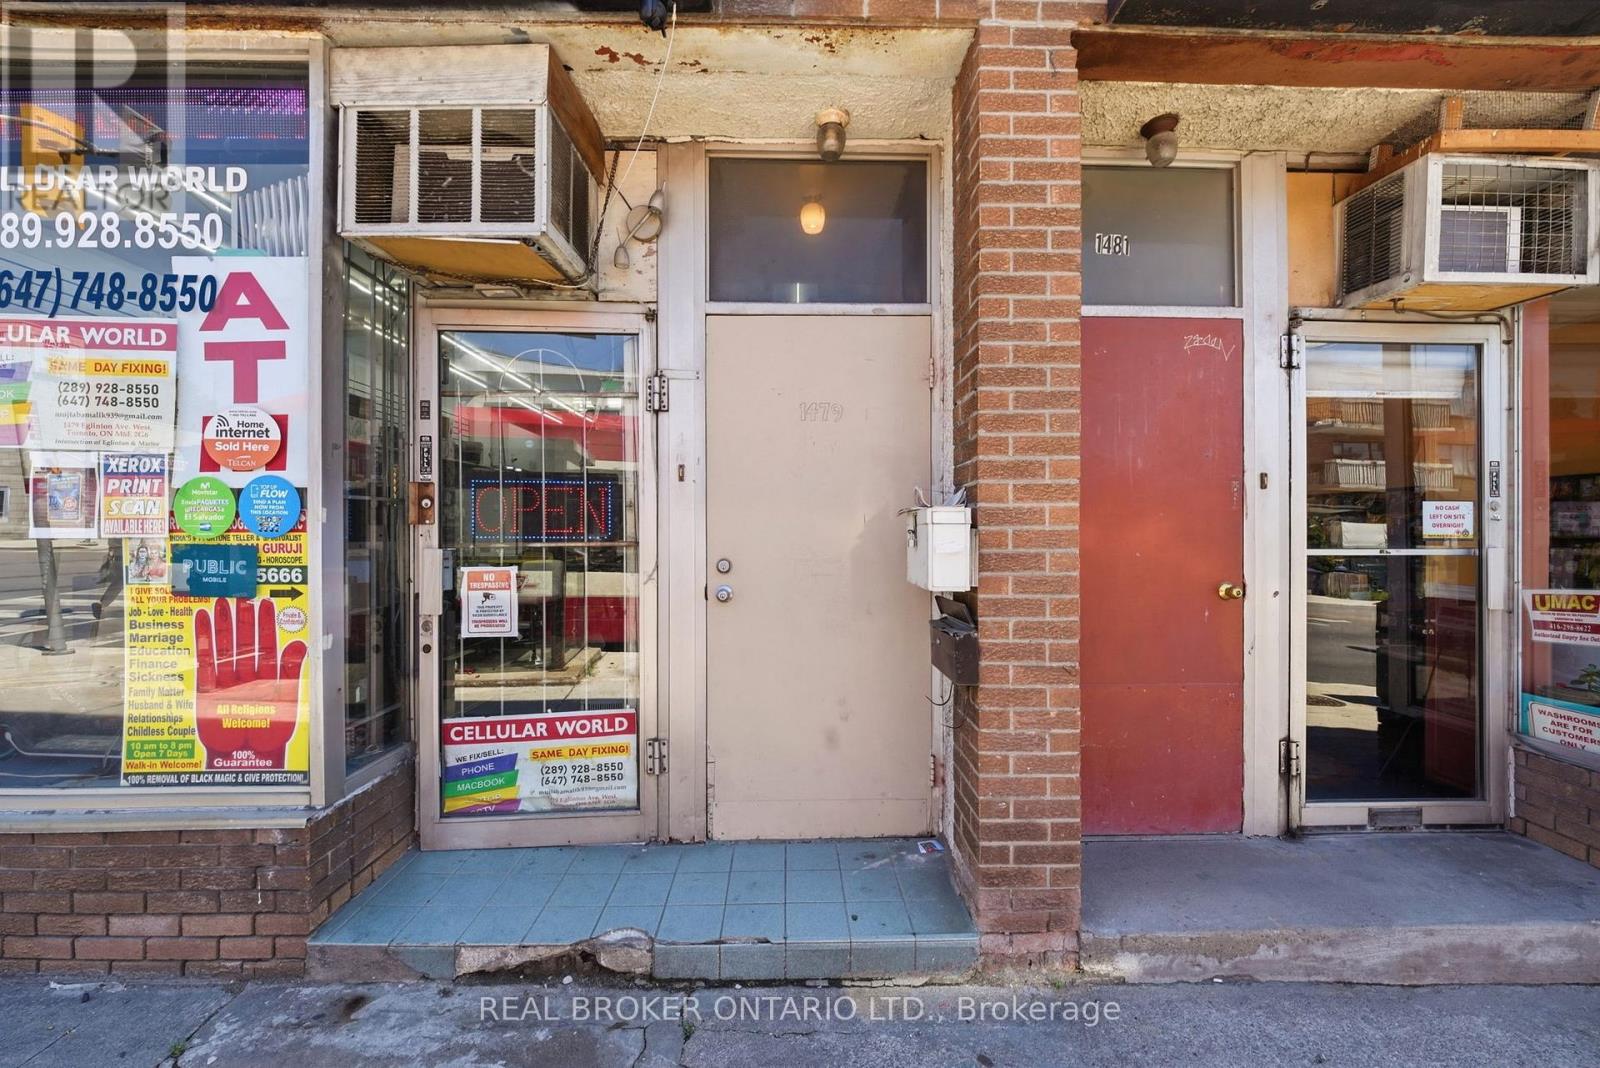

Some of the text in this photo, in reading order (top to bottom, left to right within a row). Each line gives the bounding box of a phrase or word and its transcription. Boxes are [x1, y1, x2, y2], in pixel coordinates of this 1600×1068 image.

[127, 166, 247, 192] WORLD
[1096, 234, 1130, 256] 1481
[70, 271, 217, 312] 748-8550
[0, 324, 166, 345] ULAR WORLD
[94, 363, 117, 373] DAY
[121, 363, 166, 374] FIXING!
[58, 381, 159, 395] (289) 928-8550
[57, 395, 159, 408] (647) 748-8550
[799, 401, 844, 423] 1479
[81, 423, 112, 431] Eglinton
[237, 420, 264, 428] Home
[215, 427, 270, 438] internet
[215, 441, 270, 451] Sold Here
[106, 457, 161, 473] XEROX
[106, 478, 162, 493] PRINT
[260, 489, 289, 498] FLOW
[108, 499, 160, 516] SCAN
[476, 486, 607, 535] OPEN
[104, 519, 143, 534] AVAILABLE
[262, 543, 302, 554] GURUJI
[266, 556, 303, 564] HOROSCOPE
[182, 559, 247, 575] PUBLIC
[256, 567, 303, 583] 5666
[482, 573, 495, 582] NO
[135, 587, 151, 595] GIVE
[130, 596, 145, 604] ALL
[147, 596, 166, 604] YOUR
[1534, 594, 1596, 612] UMAC
[129, 607, 193, 616] Job Love Health
[129, 619, 184, 630] Business
[129, 633, 184, 644] Marriage
[129, 646, 191, 656] Education
[129, 659, 177, 669] Finance
[128, 672, 184, 682] Sickness
[128, 687, 184, 698] Family Matter
[128, 700, 193, 709] Husband & Wife
[217, 704, 277, 716] All Religions
[128, 714, 183, 725] Relationships
[222, 718, 270, 729] Welcome!
[127, 726, 196, 738] Childless Couple
[450, 717, 628, 741] CELLULAR WORLD
[1550, 720, 1593, 736] ARE FOR
[130, 742, 141, 750] 10
[159, 742, 168, 750] to
[178, 742, 192, 751] pm
[1559, 739, 1586, 750] ONLY
[133, 750, 157, 759] Open
[166, 750, 188, 759] Days
[232, 750, 256, 759] 100%
[455, 748, 504, 763] WE FIX/SELL:
[532, 745, 629, 759] SAME DAY FIXING!
[126, 760, 202, 769] Walk-in Welcome!
[213, 758, 273, 767] Guarantee
[461, 763, 495, 775] PHONE
[540, 762, 623, 776] (289) 928-8550
[128, 774, 304, 784] 100% REMOVAL OF BLACK MAGIC & GIVE PROTECTION!
[456, 777, 505, 791] MACBOOK
[540, 773, 624, 786] (647) 748-8550
